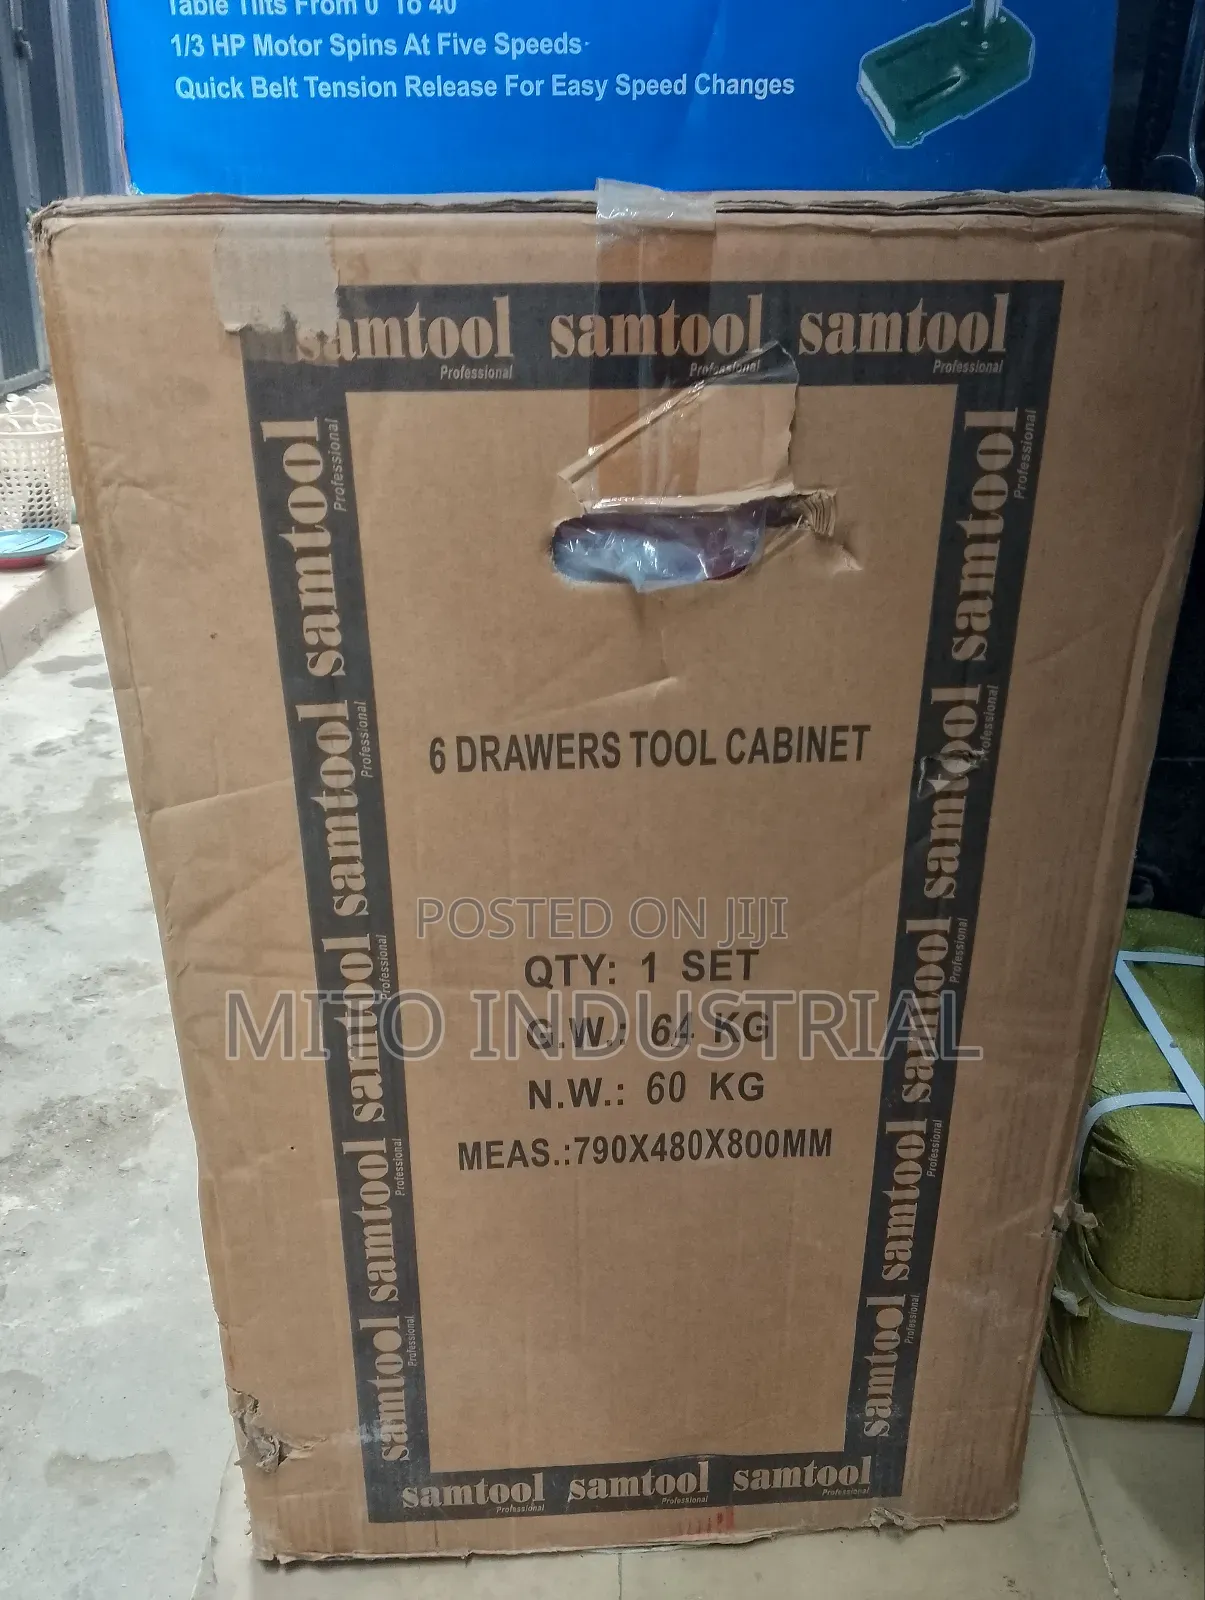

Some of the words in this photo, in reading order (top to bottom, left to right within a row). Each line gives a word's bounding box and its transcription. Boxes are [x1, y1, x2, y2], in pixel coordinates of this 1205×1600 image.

[170, 34, 205, 57] 1/3
[211, 33, 246, 57] HP
[252, 33, 323, 57] Motor
[329, 33, 397, 61] Spins
[403, 32, 430, 56] At
[437, 32, 487, 55] Five
[494, 31, 582, 60] Speeds
[175, 76, 245, 100] Quick
[250, 76, 298, 99] Belt
[303, 75, 397, 98] Tension
[405, 75, 498, 98] Release
[505, 74, 545, 97] For
[551, 74, 608, 101] Easy
[615, 73, 687, 101] Speed
[694, 72, 795, 100] Changes
[550, 293, 763, 358] samtool
[798, 292, 1009, 356] samtool
[440, 364, 513, 381] Professional
[932, 358, 1004, 375] Professional
[324, 417, 347, 512] Professional
[1013, 408, 1037, 499] Professional
[260, 416, 346, 678] samtool
[951, 407, 1018, 661] samtool
[353, 700, 374, 779] Professional
[429, 736, 446, 774] 6
[456, 730, 621, 773] DRAWERS
[630, 728, 716, 768] TOOL
[726, 724, 871, 766] CABINET
[295, 699, 369, 917] samtool
[923, 684, 982, 899] samtool
[375, 934, 392, 1000] Professional
[525, 953, 616, 989] QTY:
[641, 952, 656, 983] 1
[681, 949, 759, 982] SET
[950, 917, 969, 984] Professional
[321, 933, 386, 1122] samtool
[526, 1016, 626, 1050] G.W.:
[650, 1011, 695, 1049] 64
[713, 1010, 769, 1044] KG
[902, 916, 952, 1103] samtool
[529, 1077, 623, 1110] N.W.:
[646, 1071, 686, 1105] 60
[709, 1072, 764, 1101] KG
[392, 1138, 405, 1196] Professional
[458, 1127, 832, 1171] MEAS.:790X480X800MM
[927, 1119, 943, 1177] Professional
[341, 1138, 399, 1302] samtool
[882, 1118, 927, 1281] samtool
[405, 1316, 417, 1367] Professional
[904, 1293, 921, 1344] Professional
[358, 1315, 410, 1461] samtool
[864, 1294, 906, 1437] samtool
[403, 1472, 545, 1509] samtool
[568, 1460, 710, 1502] samtool
[733, 1455, 872, 1492] samtool
[661, 1495, 708, 1505] Professional
